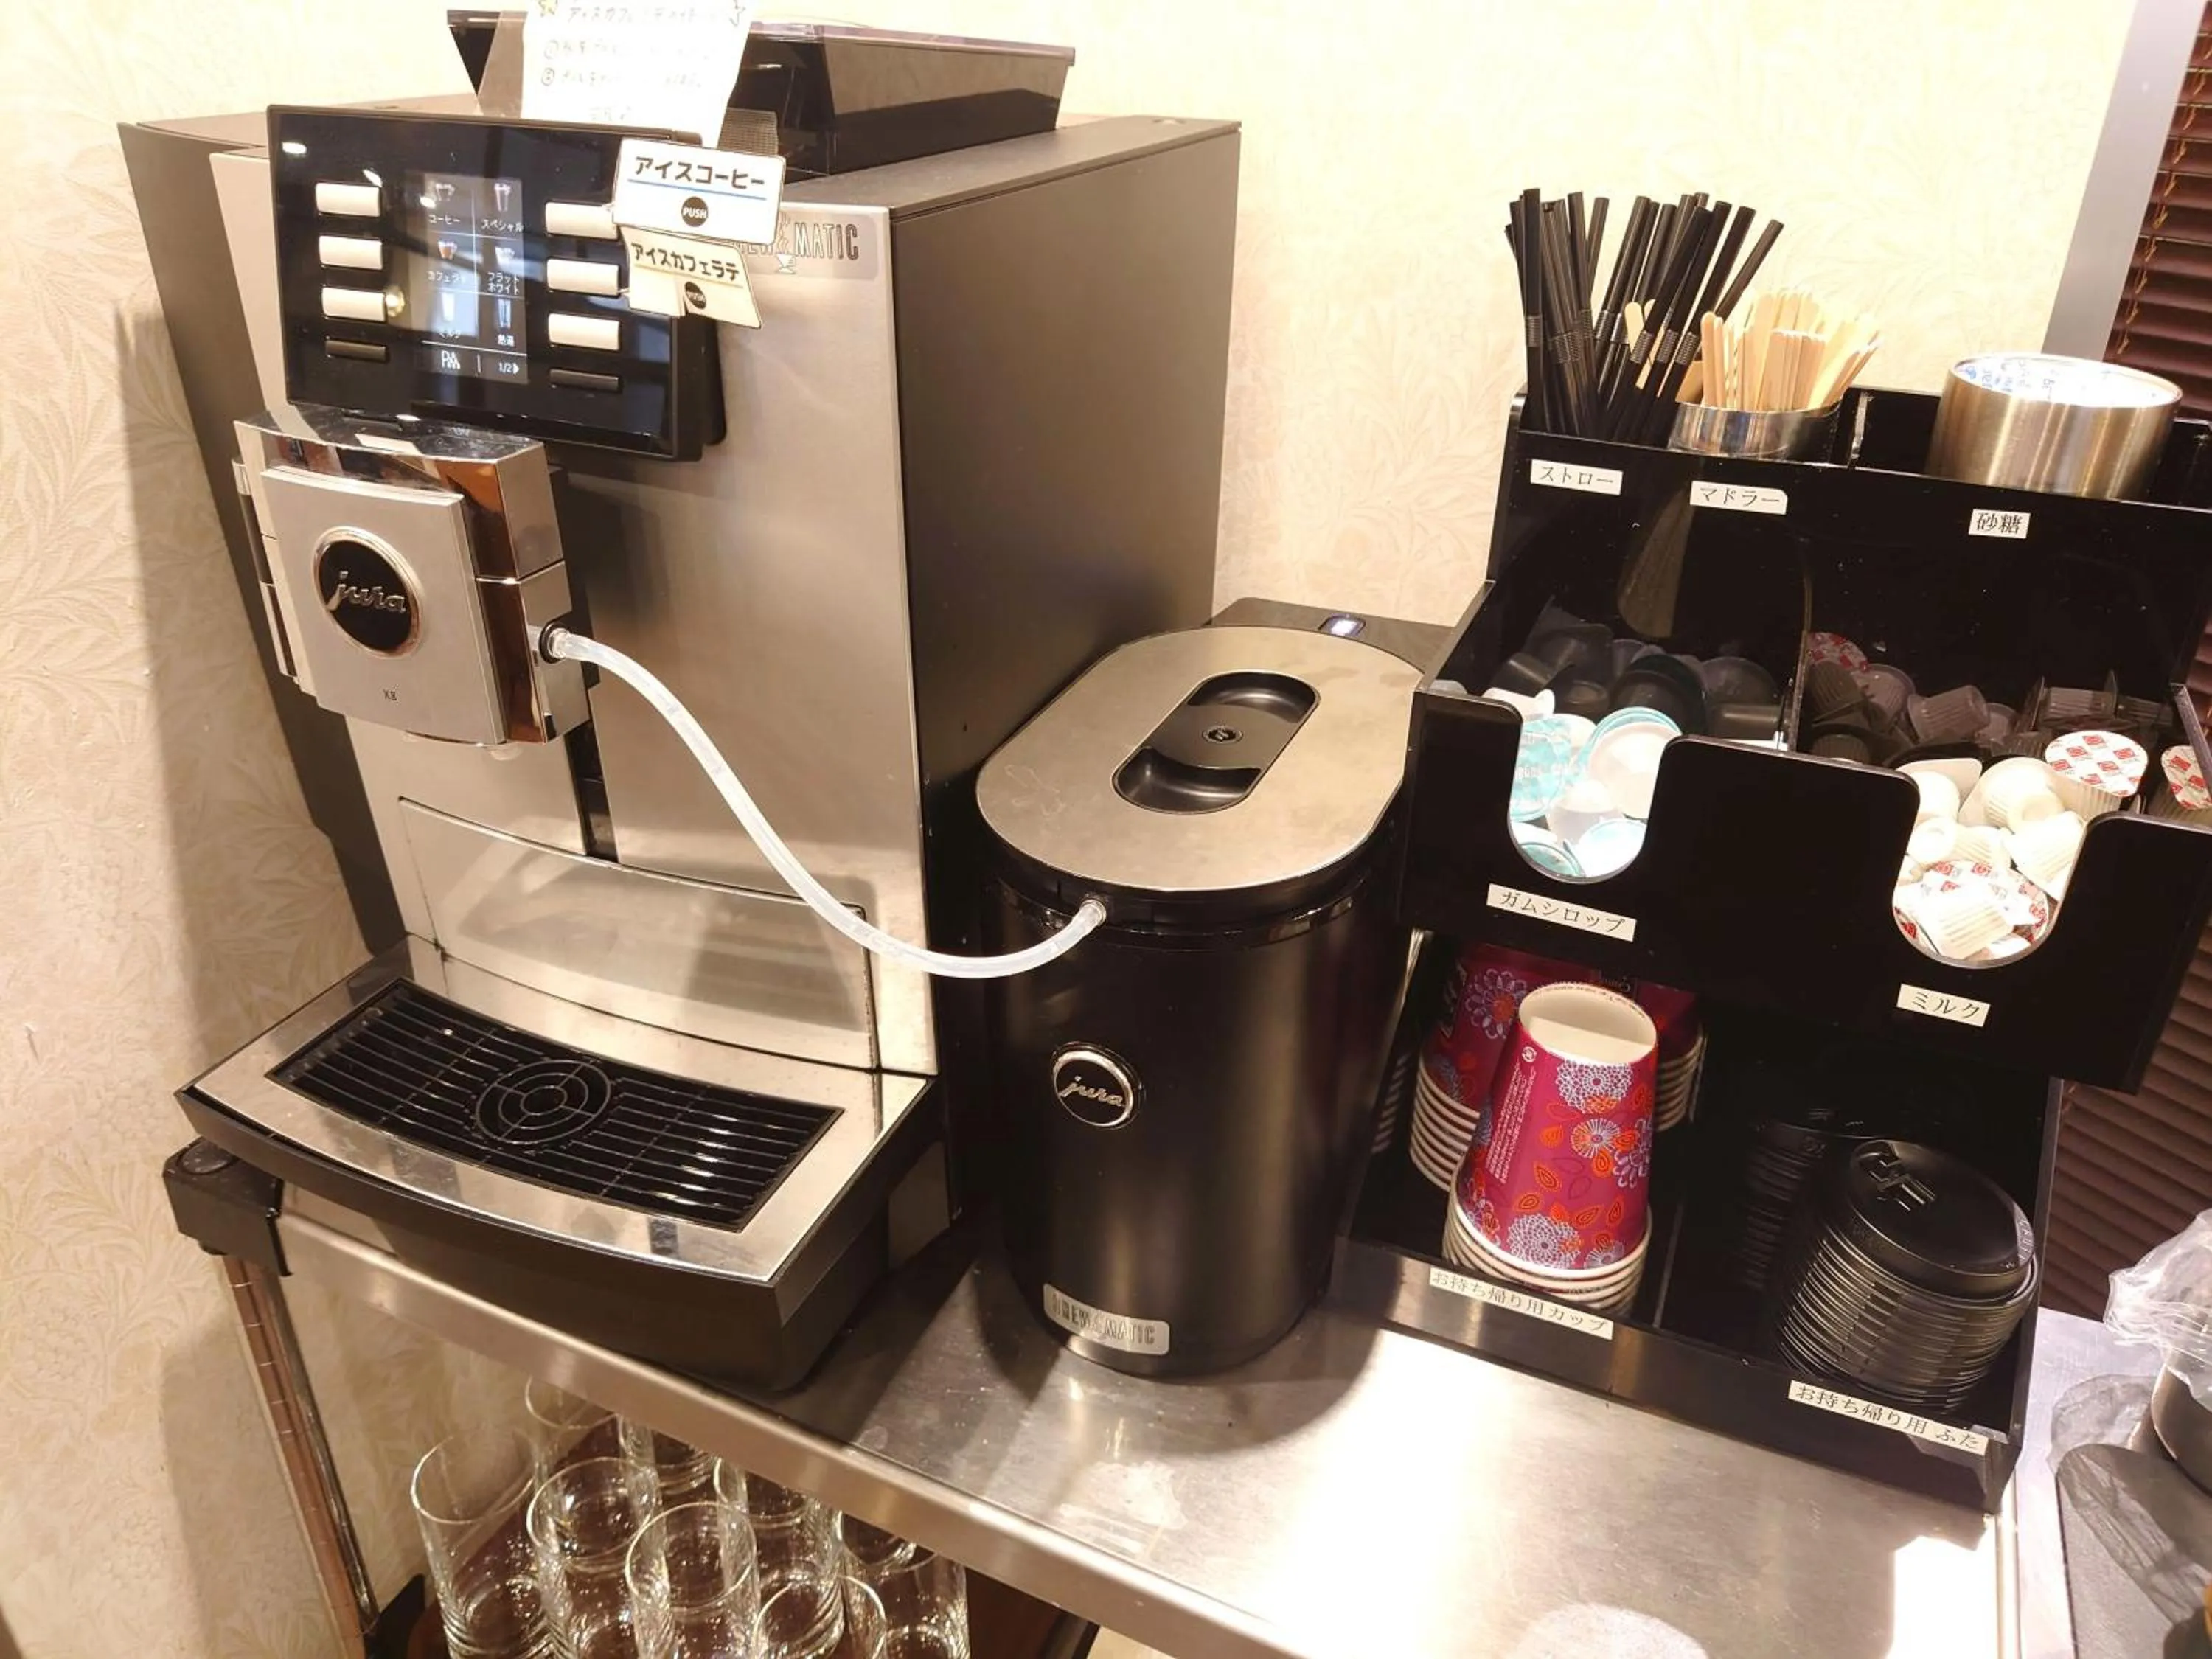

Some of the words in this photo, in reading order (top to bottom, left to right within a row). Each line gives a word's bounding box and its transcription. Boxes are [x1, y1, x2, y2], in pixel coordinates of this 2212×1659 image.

[634, 156, 765, 189] アイスコーヒー
[428, 214, 461, 226] コーヒー
[481, 219, 524, 232] スペシャル
[682, 206, 707, 220] PUSH
[794, 222, 859, 260] MATIC
[631, 243, 740, 281] アイスカフェラテ
[427, 271, 467, 284] カフェラ
[1539, 466, 1614, 485] ストロー
[1700, 487, 1780, 507] マドラー
[1977, 513, 2023, 534] 砂糖
[326, 571, 406, 614] jura
[1500, 891, 1626, 933] ガムシロップ
[1912, 992, 1980, 1019] ミルク
[1058, 1076, 1125, 1107] jura
[1432, 1273, 1609, 1332] お持ち帰り用カップ
